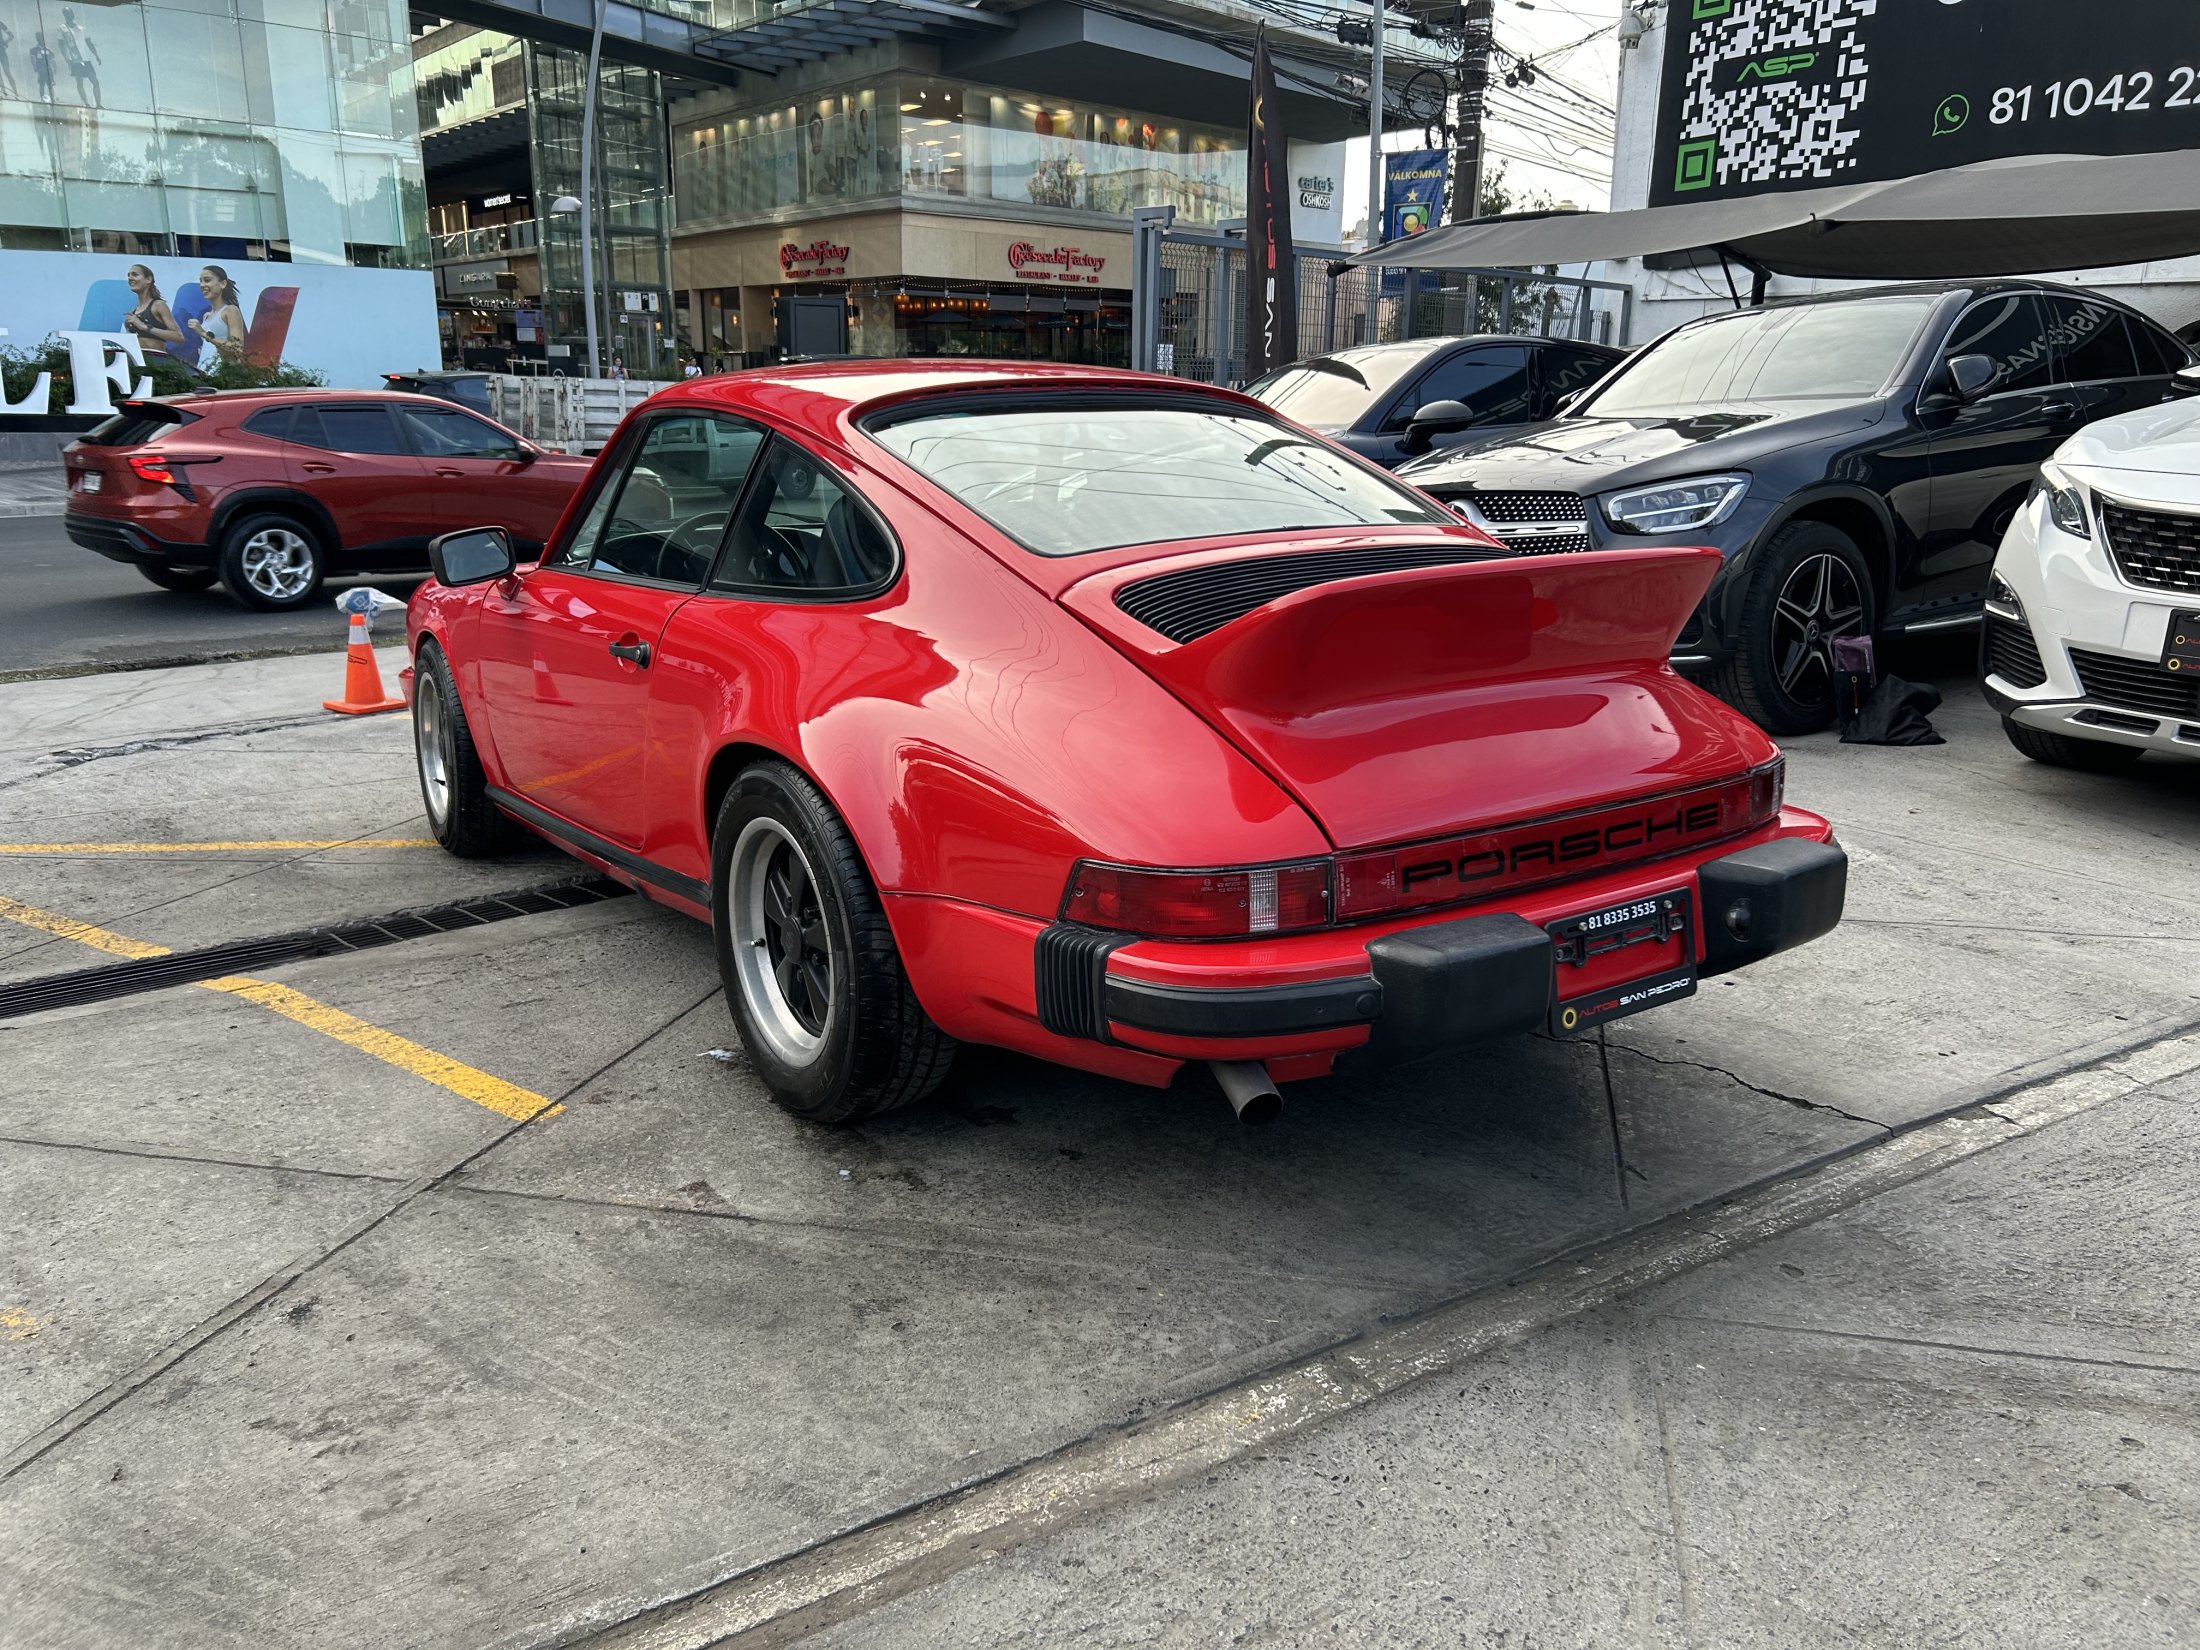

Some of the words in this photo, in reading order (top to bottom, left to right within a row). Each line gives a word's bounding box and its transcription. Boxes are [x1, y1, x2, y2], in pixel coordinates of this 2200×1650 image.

[1736, 52, 1814, 82] ASP
[1988, 85, 2032, 124] 81
[2044, 71, 2153, 119] 1042
[1388, 169, 1442, 181] VÄLKOMNA
[1008, 242, 1066, 269] Cheesecake
[1061, 247, 1105, 272] Factory
[1402, 802, 1719, 893] PORSCHE
[1588, 915, 1603, 930] 81
[1604, 908, 1630, 926] 8335
[1631, 901, 1657, 919] 3535
[1578, 999, 1619, 1018] AUTOS
[1619, 990, 1647, 1006] SAN
[1647, 978, 1690, 997] PEDRO
